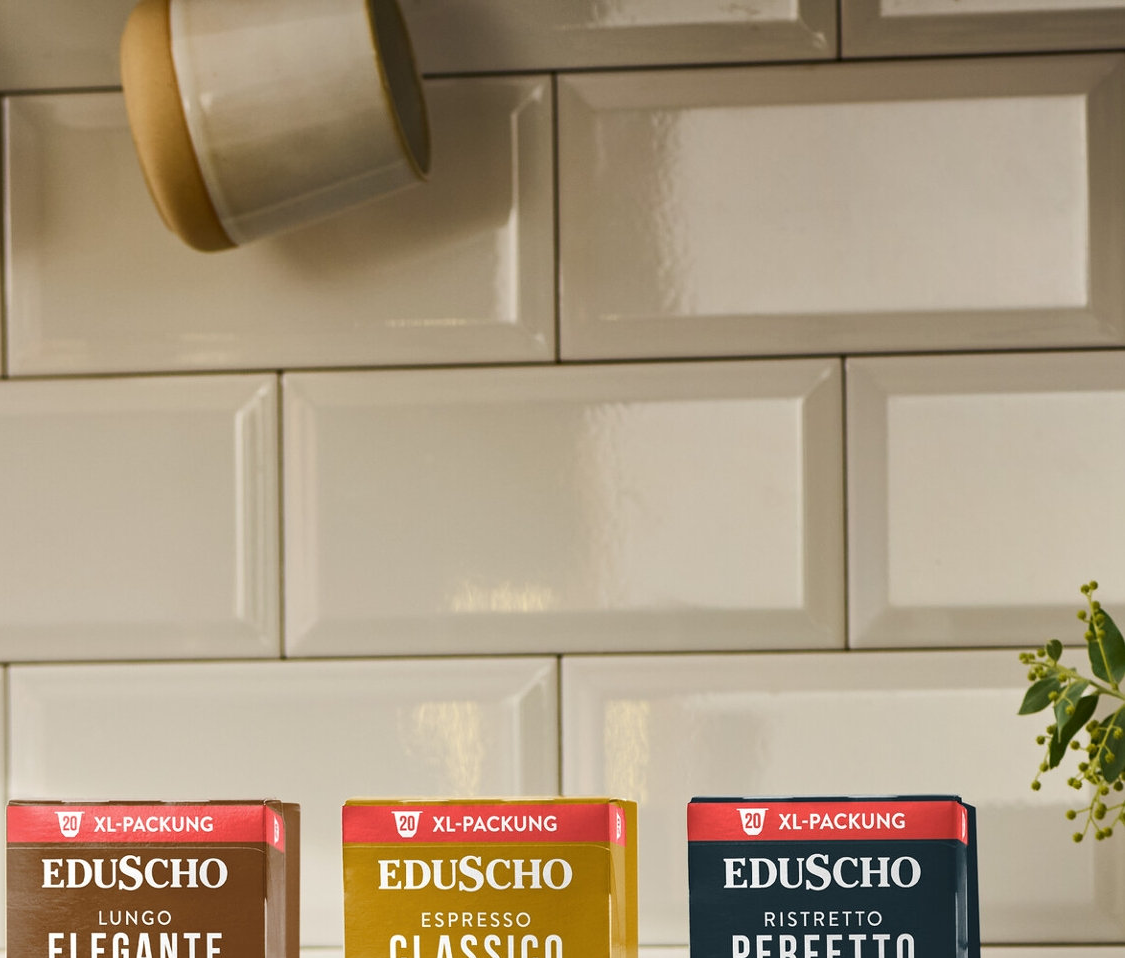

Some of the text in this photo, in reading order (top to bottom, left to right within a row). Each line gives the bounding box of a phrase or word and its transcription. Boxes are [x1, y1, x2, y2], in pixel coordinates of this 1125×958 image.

[63, 816, 214, 832] 20 XL-PACKUNG
[399, 816, 557, 832] 20 XL-PACKUNG
[745, 813, 905, 830] 20 XL-PACKUNG
[42, 855, 228, 890] EDUSCHO
[378, 856, 572, 891] EDUSCHO
[723, 853, 921, 890] EDUSCHO
[98, 911, 172, 925] LUNGO
[422, 912, 531, 927] ESPRESSO
[765, 910, 882, 927] RISTRETTO
